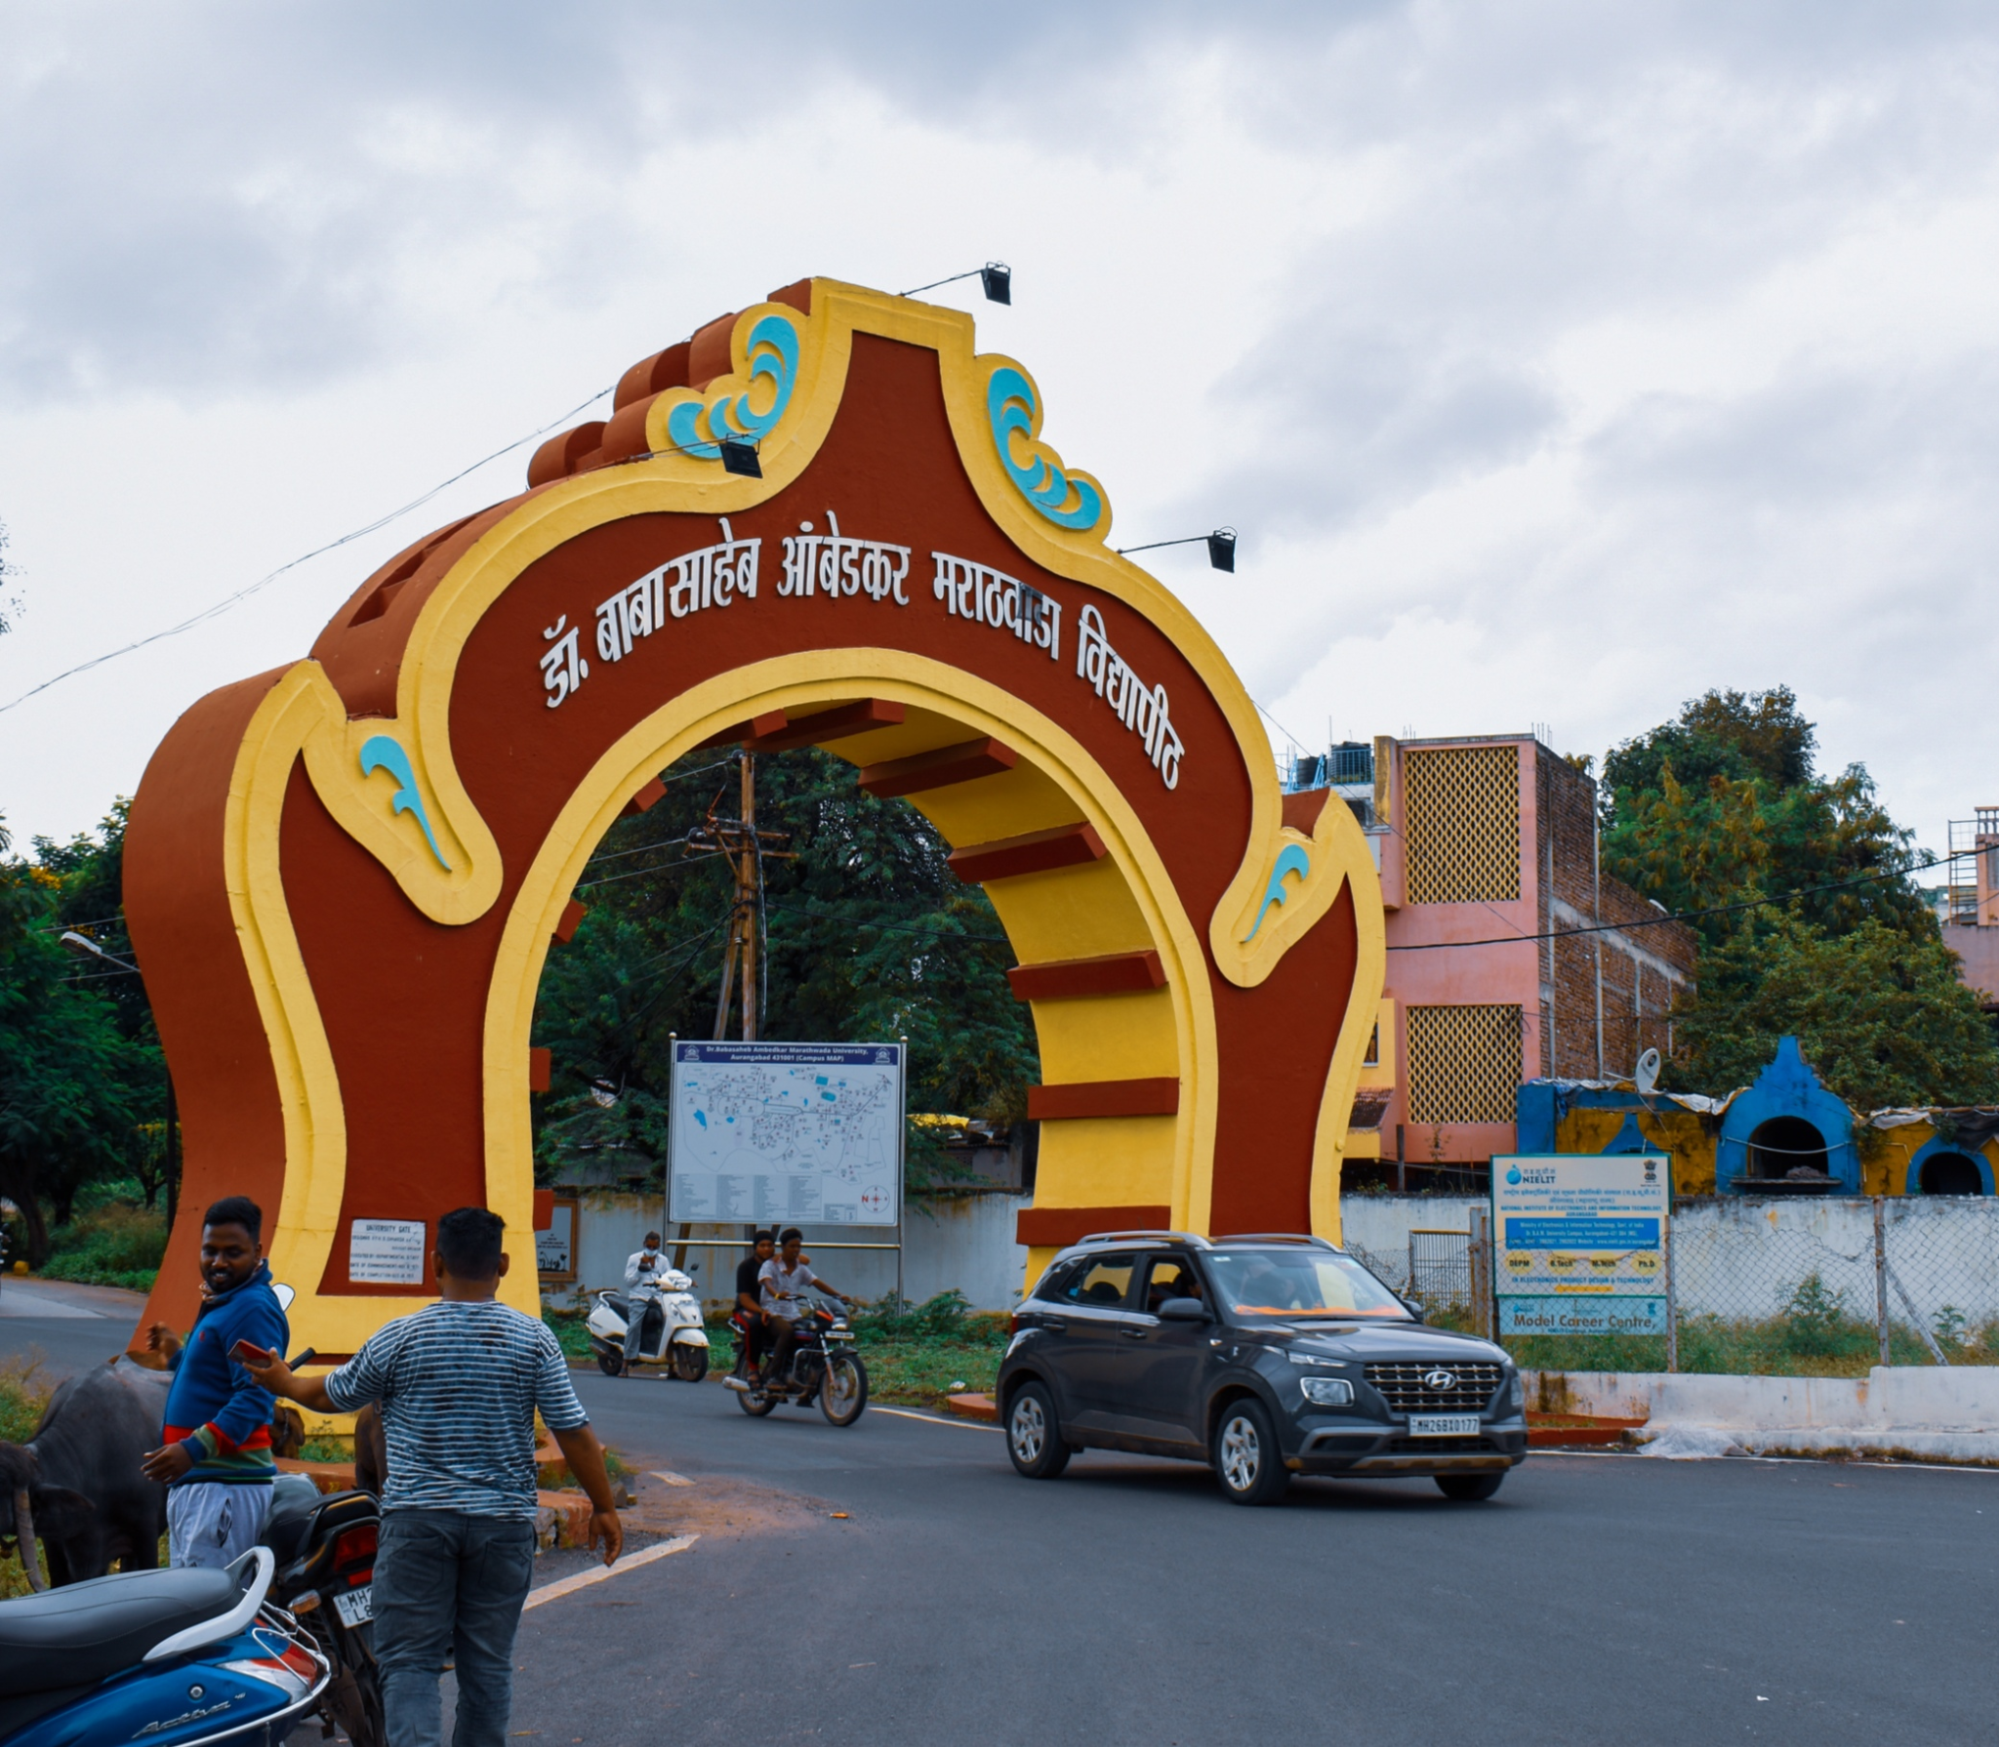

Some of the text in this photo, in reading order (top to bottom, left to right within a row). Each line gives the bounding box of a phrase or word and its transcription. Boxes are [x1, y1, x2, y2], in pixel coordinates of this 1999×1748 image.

[539, 510, 1185, 790] डॉ. बाबासाहेब आंबेडकर मराठवाडा विद्यापीठ
[730, 1054, 770, 1062] Aurangabad
[833, 1048, 868, 1056] University,
[1514, 1314, 1656, 1329] Model Career Centre,
[132, 1701, 231, 1739] Activa
